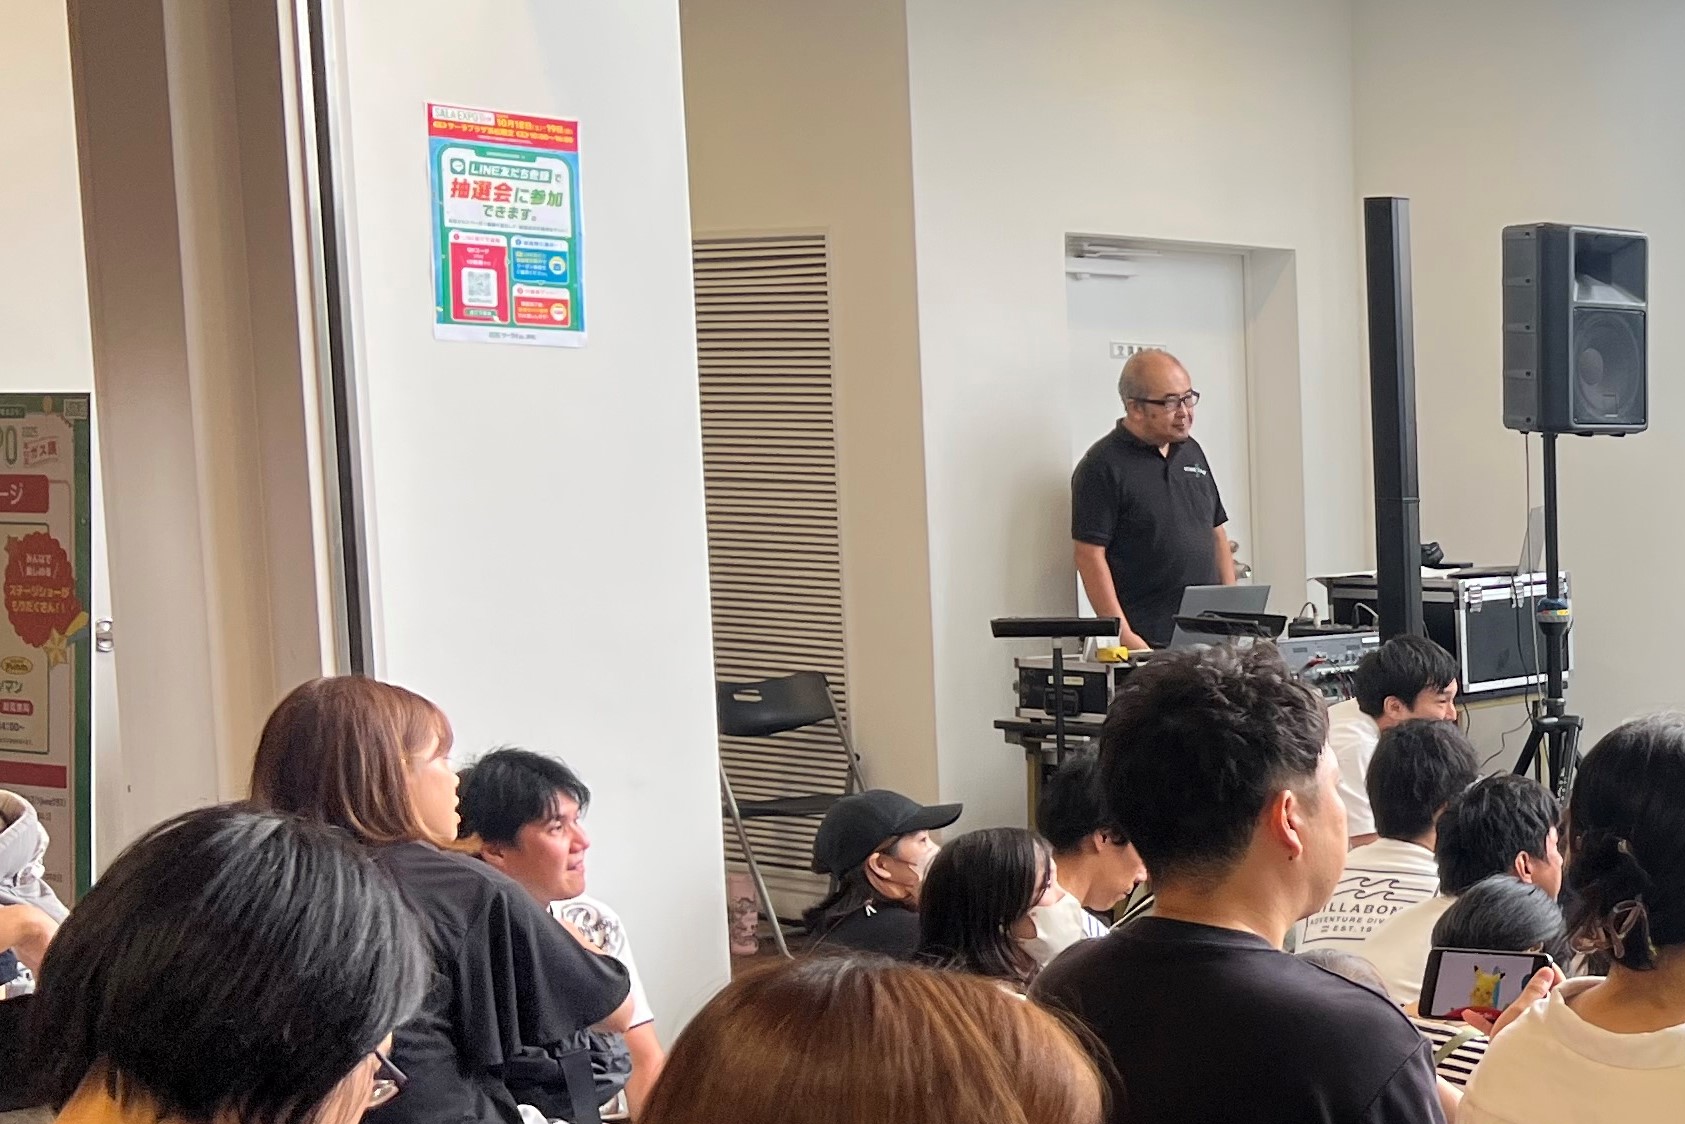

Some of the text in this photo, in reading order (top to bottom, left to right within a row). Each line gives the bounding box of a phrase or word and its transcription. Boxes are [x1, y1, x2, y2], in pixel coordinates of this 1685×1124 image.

[450, 177, 564, 208] 抽選会に参加
[482, 203, 537, 222] できます。
[1310, 915, 1364, 925] ADVENTURE
